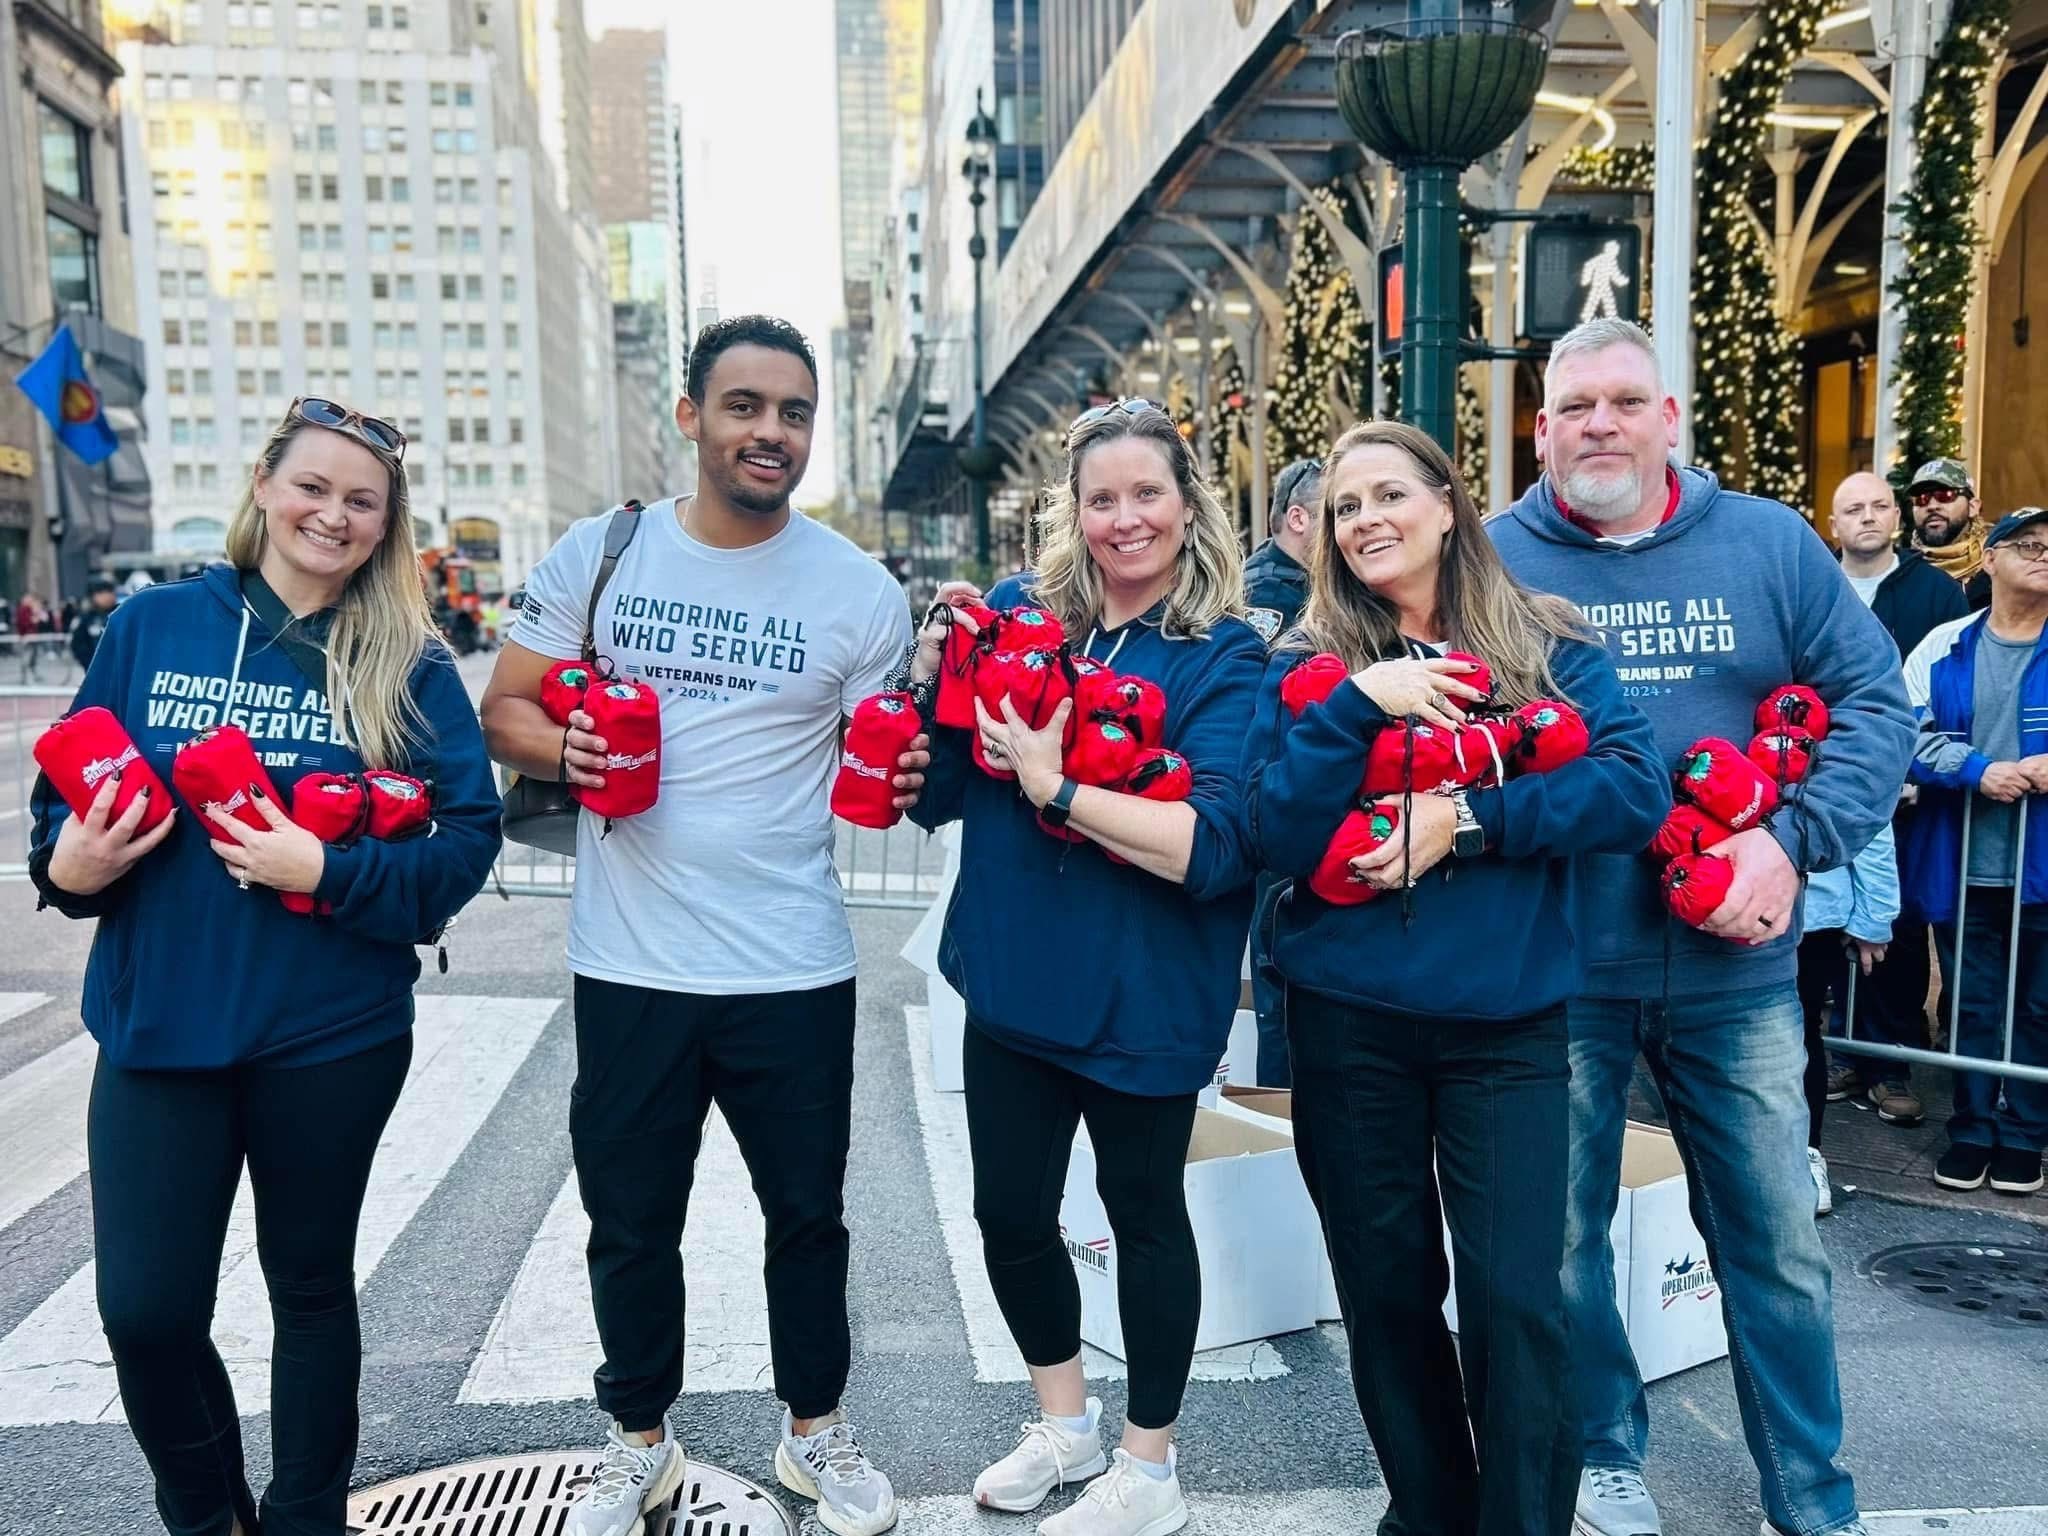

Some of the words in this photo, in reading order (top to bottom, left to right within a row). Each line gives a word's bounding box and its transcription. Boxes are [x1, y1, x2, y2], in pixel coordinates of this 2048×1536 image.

[614, 594, 748, 633] HONORING
[761, 616, 806, 643] ALL
[1684, 598, 1732, 622] ALL
[612, 621, 676, 653] WHO
[691, 633, 806, 674] SERVED
[1621, 624, 1735, 656] SERVED
[645, 665, 723, 686] VETERANS
[727, 676, 757, 692] DAY
[1663, 665, 1695, 681] DAY
[150, 671, 293, 709] HONORING
[679, 686, 717, 702] 2024
[1622, 685, 1660, 697] 2024
[147, 699, 217, 731] WHO
[264, 752, 299, 767] DAY
[1661, 1271, 1705, 1297] OPERATION
